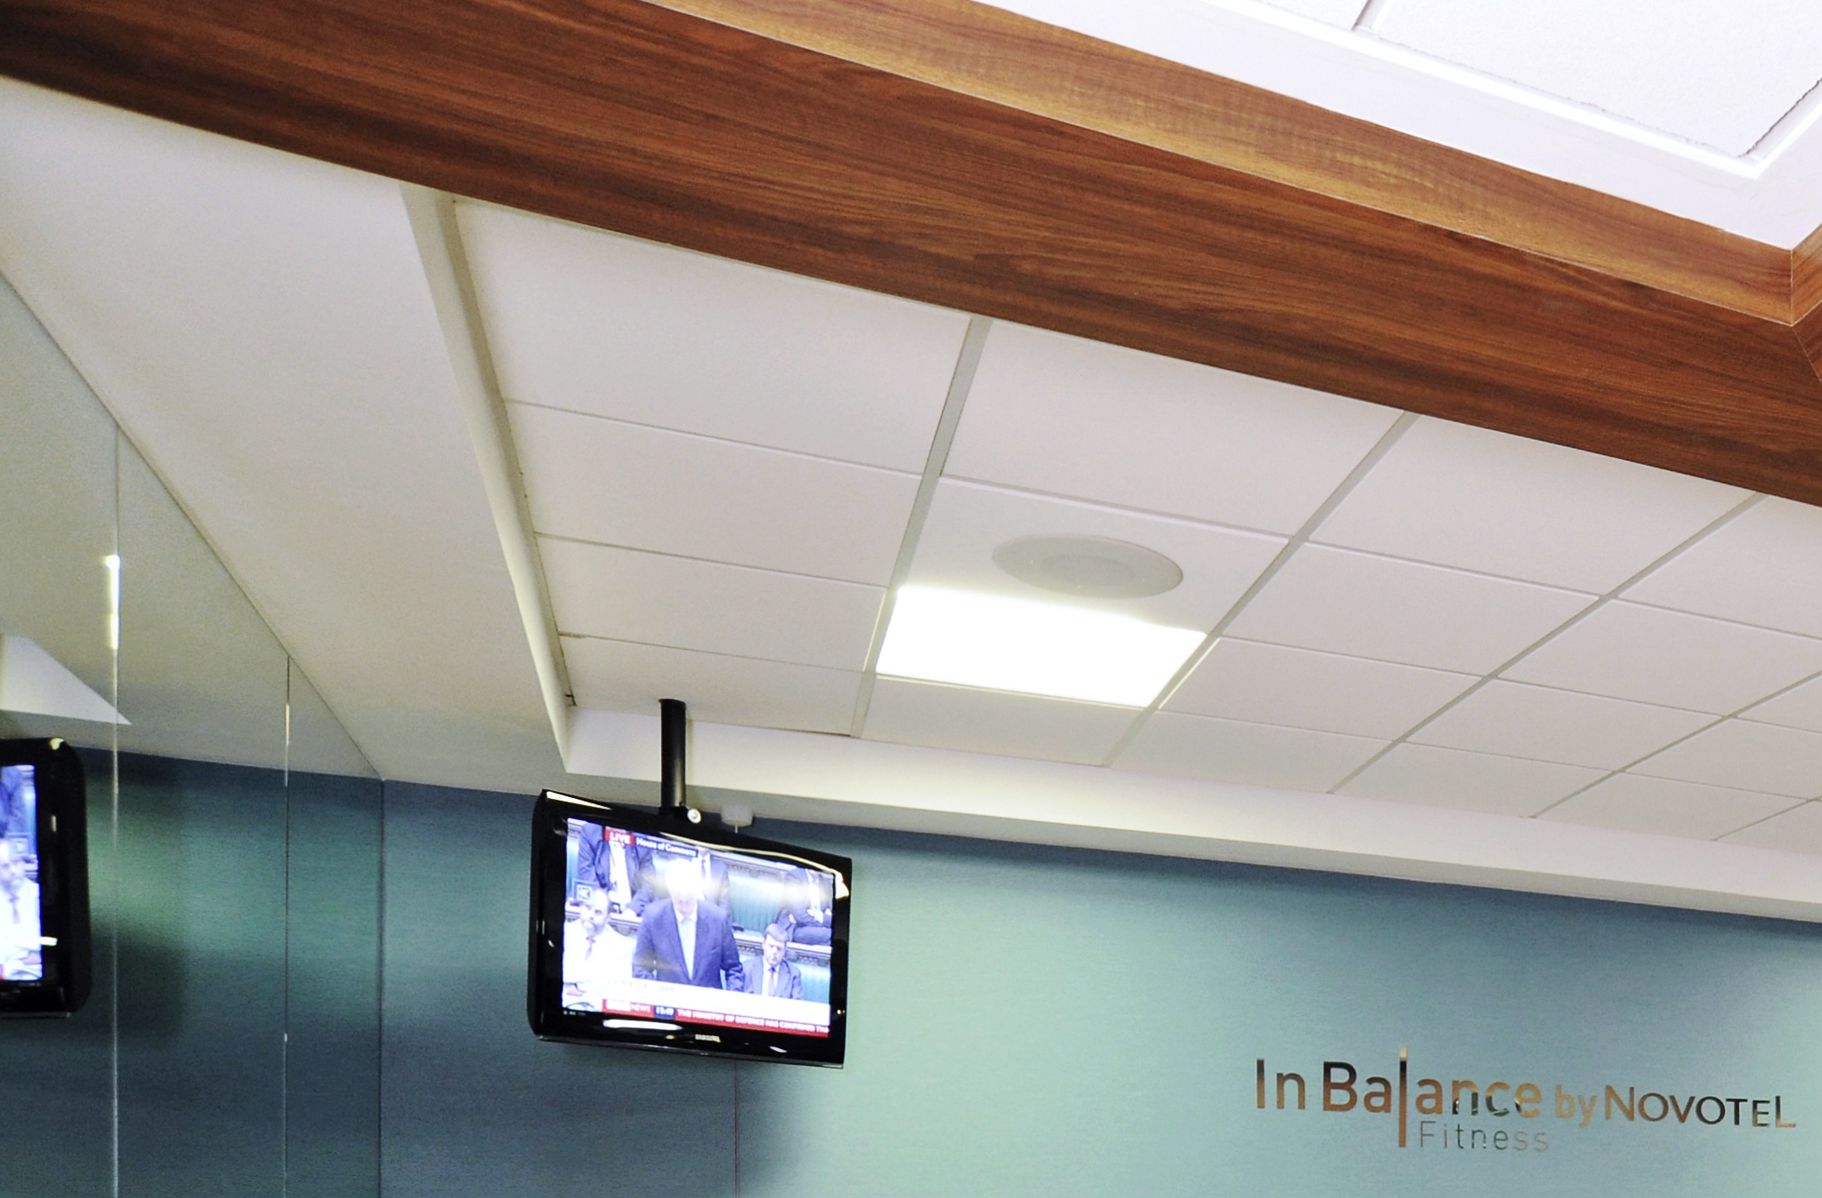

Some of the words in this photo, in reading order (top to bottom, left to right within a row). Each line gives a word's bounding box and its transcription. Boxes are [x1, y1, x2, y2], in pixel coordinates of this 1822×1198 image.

[610, 831, 631, 845] LIVE
[1255, 1058, 1306, 1110] In
[1322, 1044, 1542, 1149] Balance
[1555, 1085, 1598, 1127] by
[1604, 1085, 1797, 1129] NOVOTEL
[1419, 1120, 1550, 1152] Fitness
